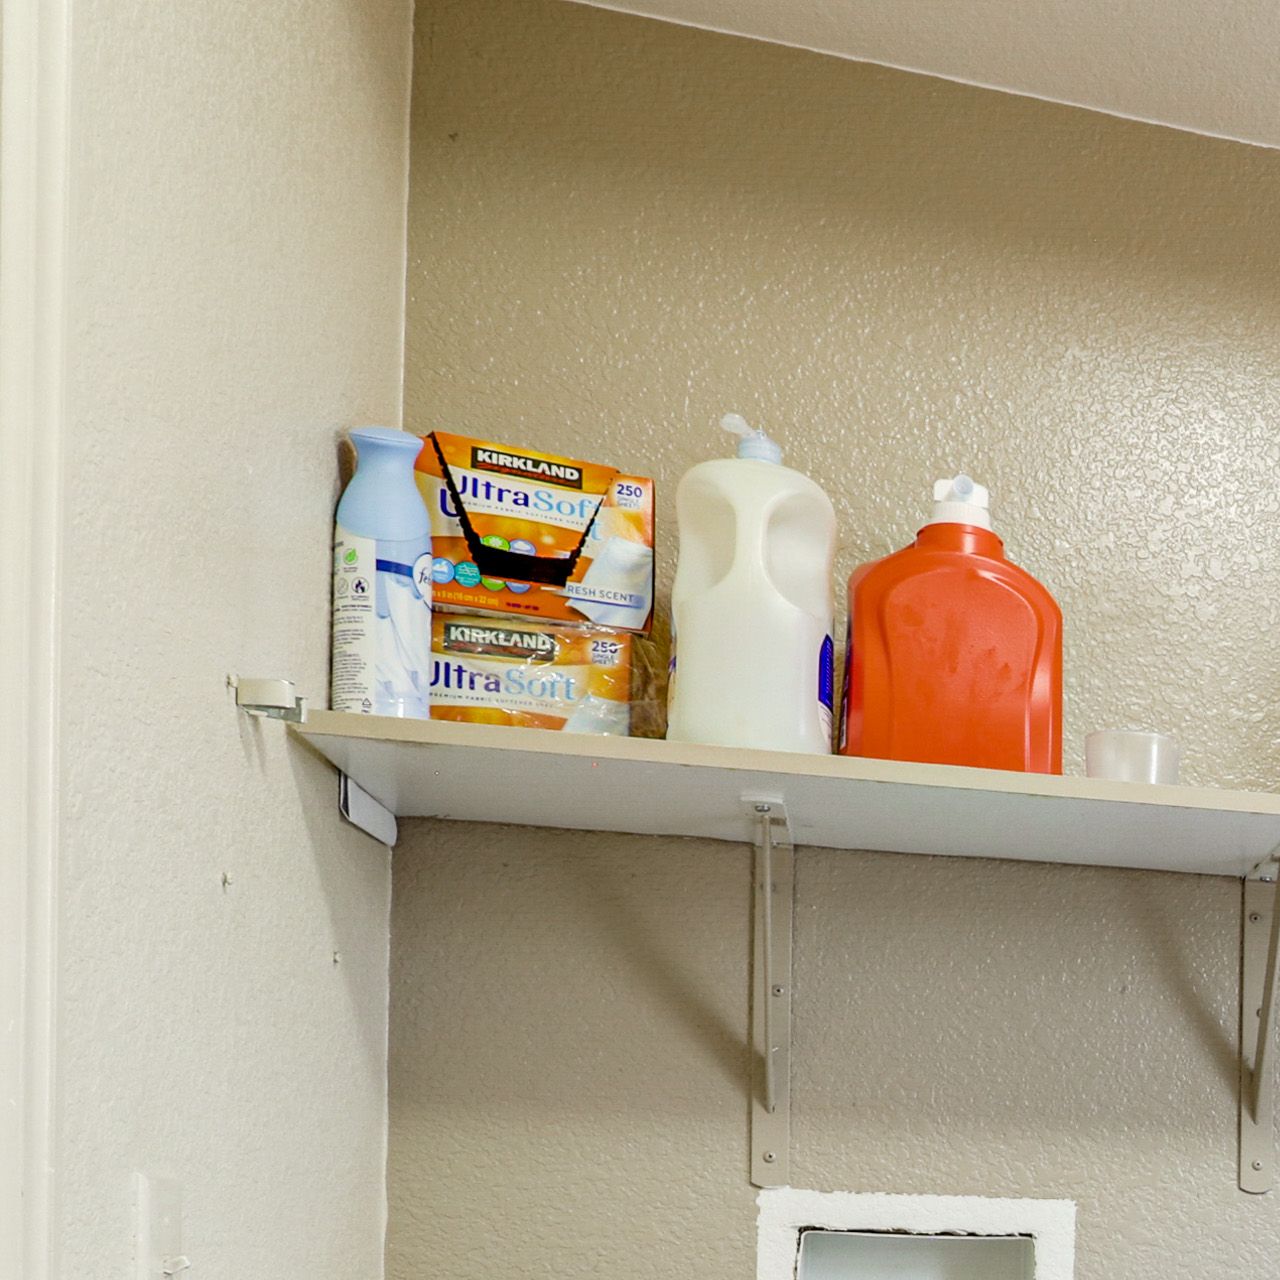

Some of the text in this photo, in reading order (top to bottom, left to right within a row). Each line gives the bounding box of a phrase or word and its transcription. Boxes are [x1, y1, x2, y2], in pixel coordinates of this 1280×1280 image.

[476, 449, 580, 481] KIRKLAND
[616, 483, 643, 498] 250
[567, 584, 635, 603] RESH SCENT
[450, 625, 552, 651] KIRKLAND
[592, 640, 619, 652] 250
